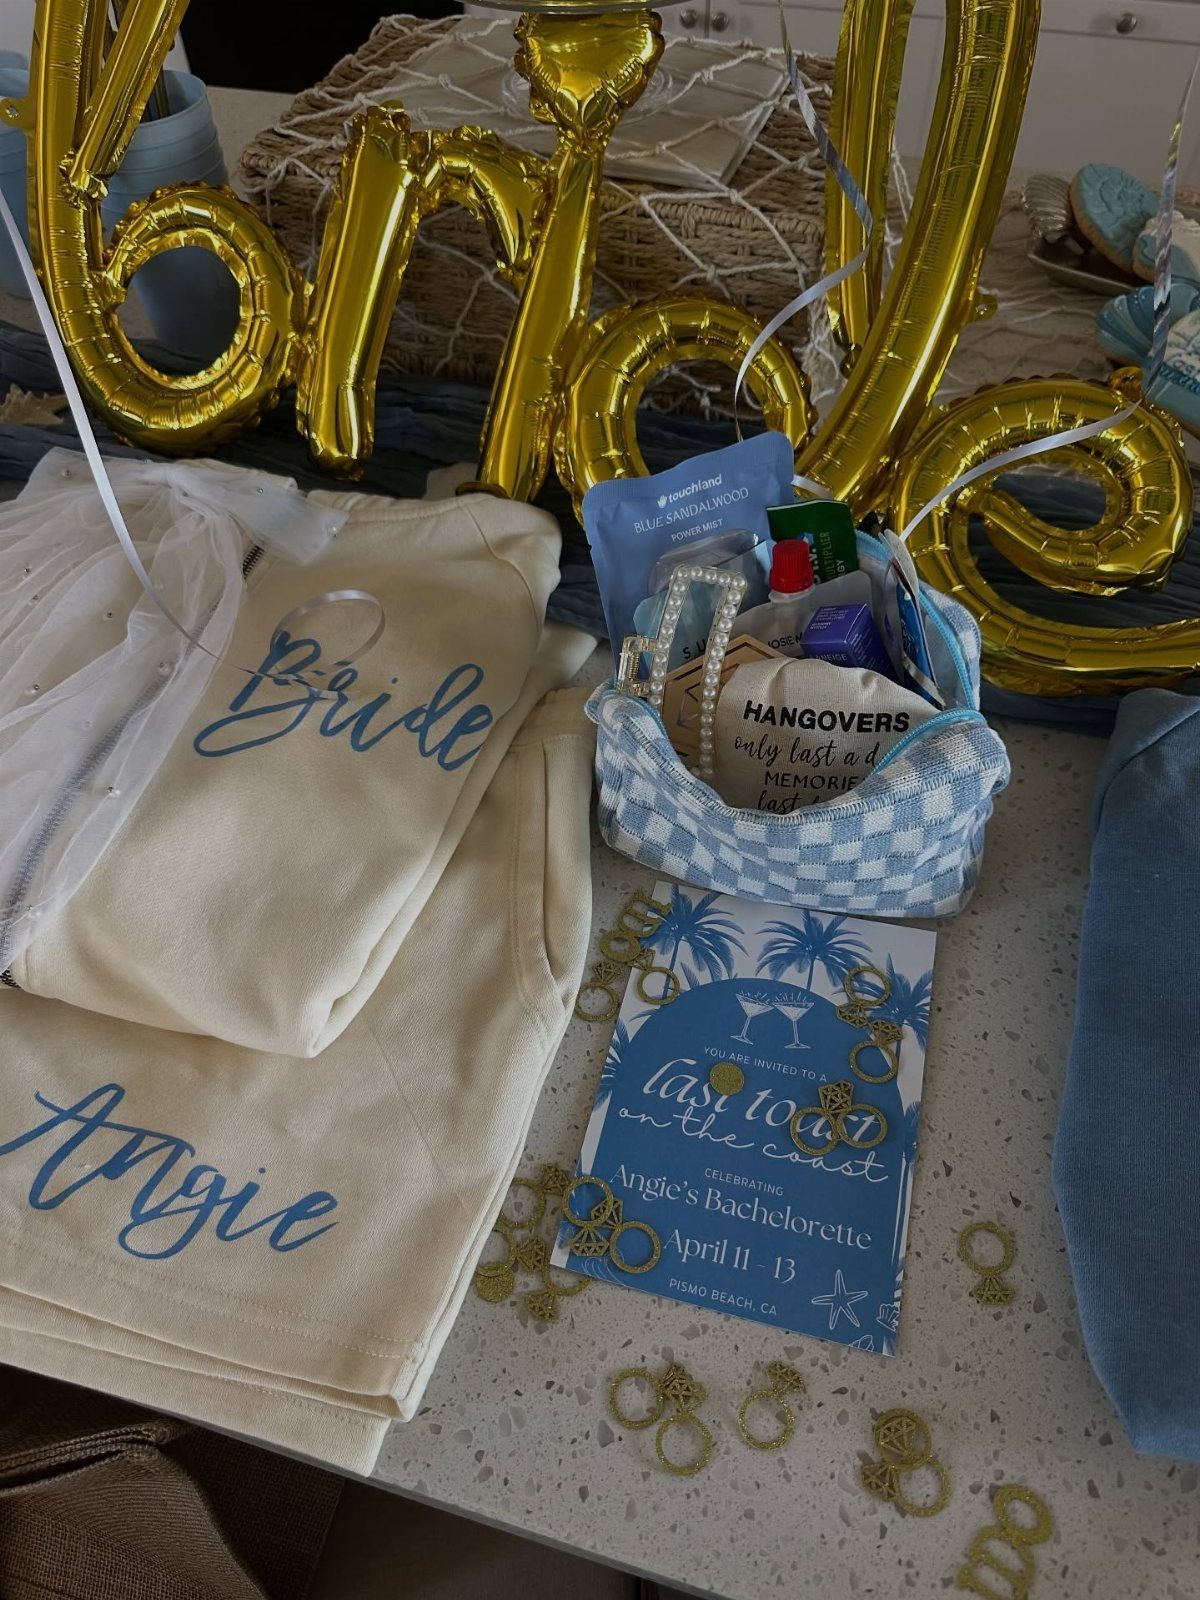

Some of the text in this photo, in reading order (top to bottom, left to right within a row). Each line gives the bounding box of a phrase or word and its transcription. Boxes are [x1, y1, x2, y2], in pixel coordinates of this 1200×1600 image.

[668, 474, 722, 503] touchland
[634, 488, 749, 534] BLUE SANDALWOOD
[671, 519, 723, 542] POWER MIST
[194, 631, 493, 771] Bride
[743, 700, 910, 733] HANGOVERS
[735, 734, 782, 767] only
[790, 737, 837, 767] last
[844, 754, 859, 766] a
[765, 771, 867, 791] MEMORIE
[758, 790, 801, 815] last
[704, 1046, 828, 1083] YOU ARE INVITED TO A
[619, 1106, 889, 1183] on the coast
[0, 1083, 339, 1259] Angie
[704, 1167, 784, 1197] CELEBRATING
[609, 1164, 873, 1250] Angie's Bachelorette
[663, 1229, 729, 1266] April
[733, 1246, 751, 1271] 11
[774, 1255, 797, 1284] 13
[669, 1277, 778, 1317] PISMO BEACH, CA
